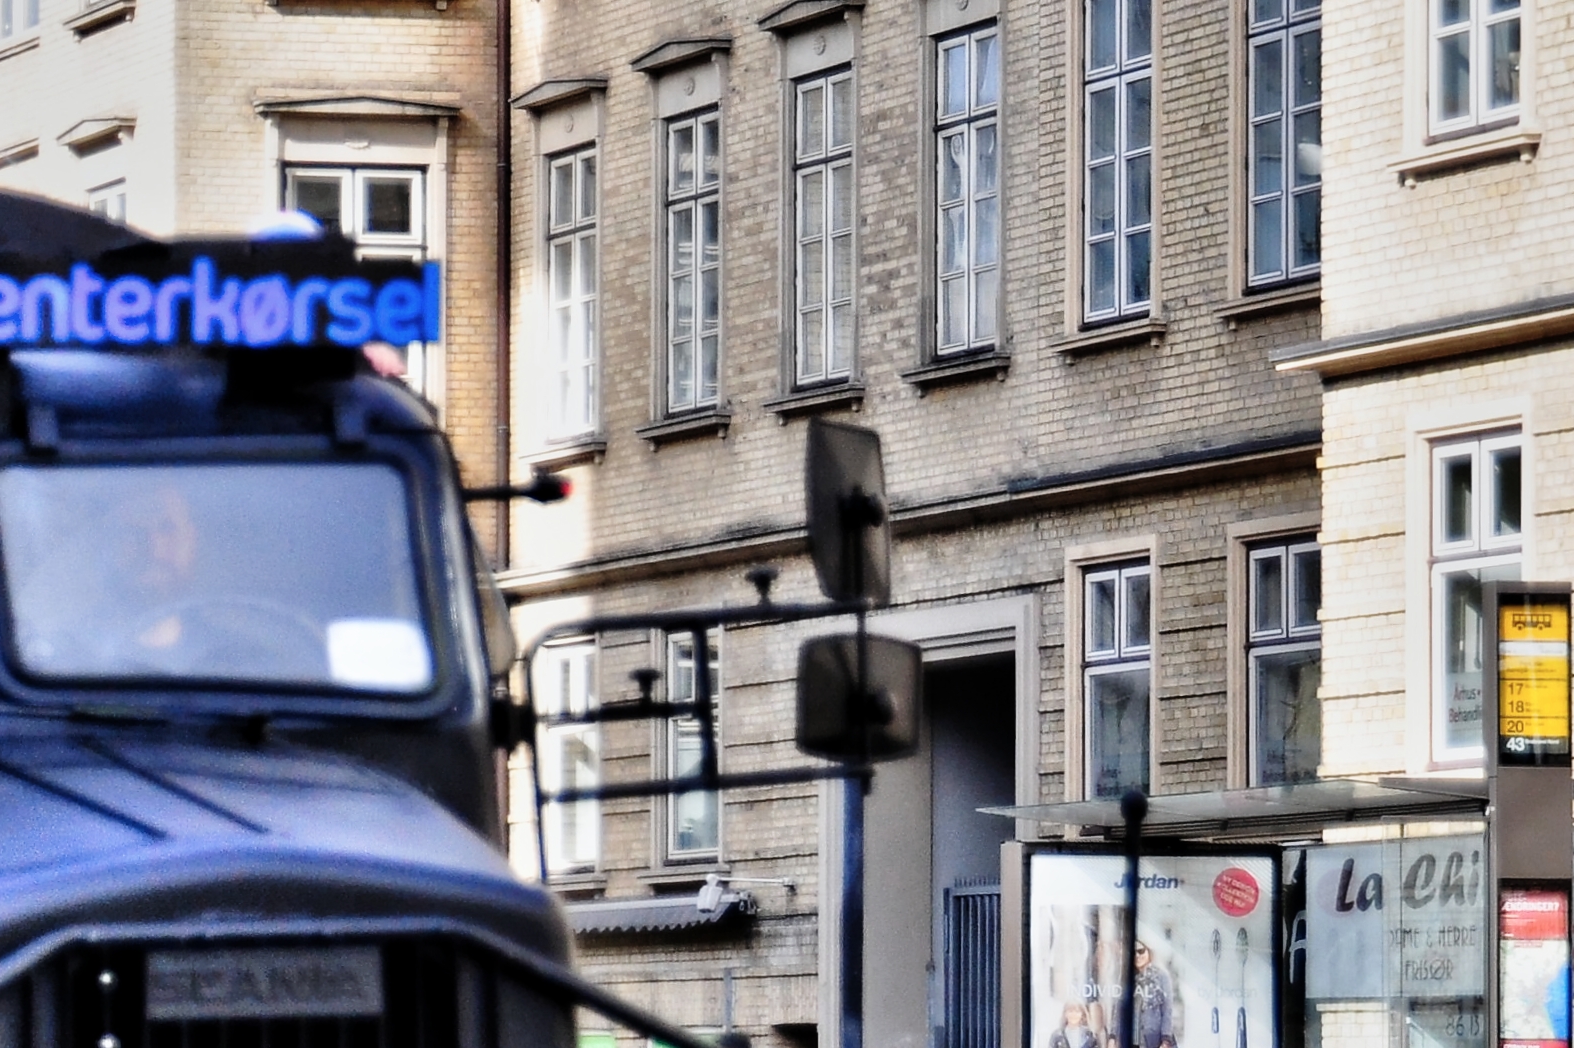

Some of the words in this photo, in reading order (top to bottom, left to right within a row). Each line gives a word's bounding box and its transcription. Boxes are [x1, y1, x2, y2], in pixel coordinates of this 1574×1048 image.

[1507, 683, 1523, 696] 17
[1507, 700, 1524, 713] 18
[1507, 720, 1524, 733] 20
[1506, 737, 1525, 751] 43
[1114, 874, 1179, 889] Jrdan
[1335, 858, 1383, 912] La
[1439, 924, 1477, 947] HERRE
[1405, 958, 1453, 981] FRISØR
[1068, 983, 1153, 998] INDIVIDAL
